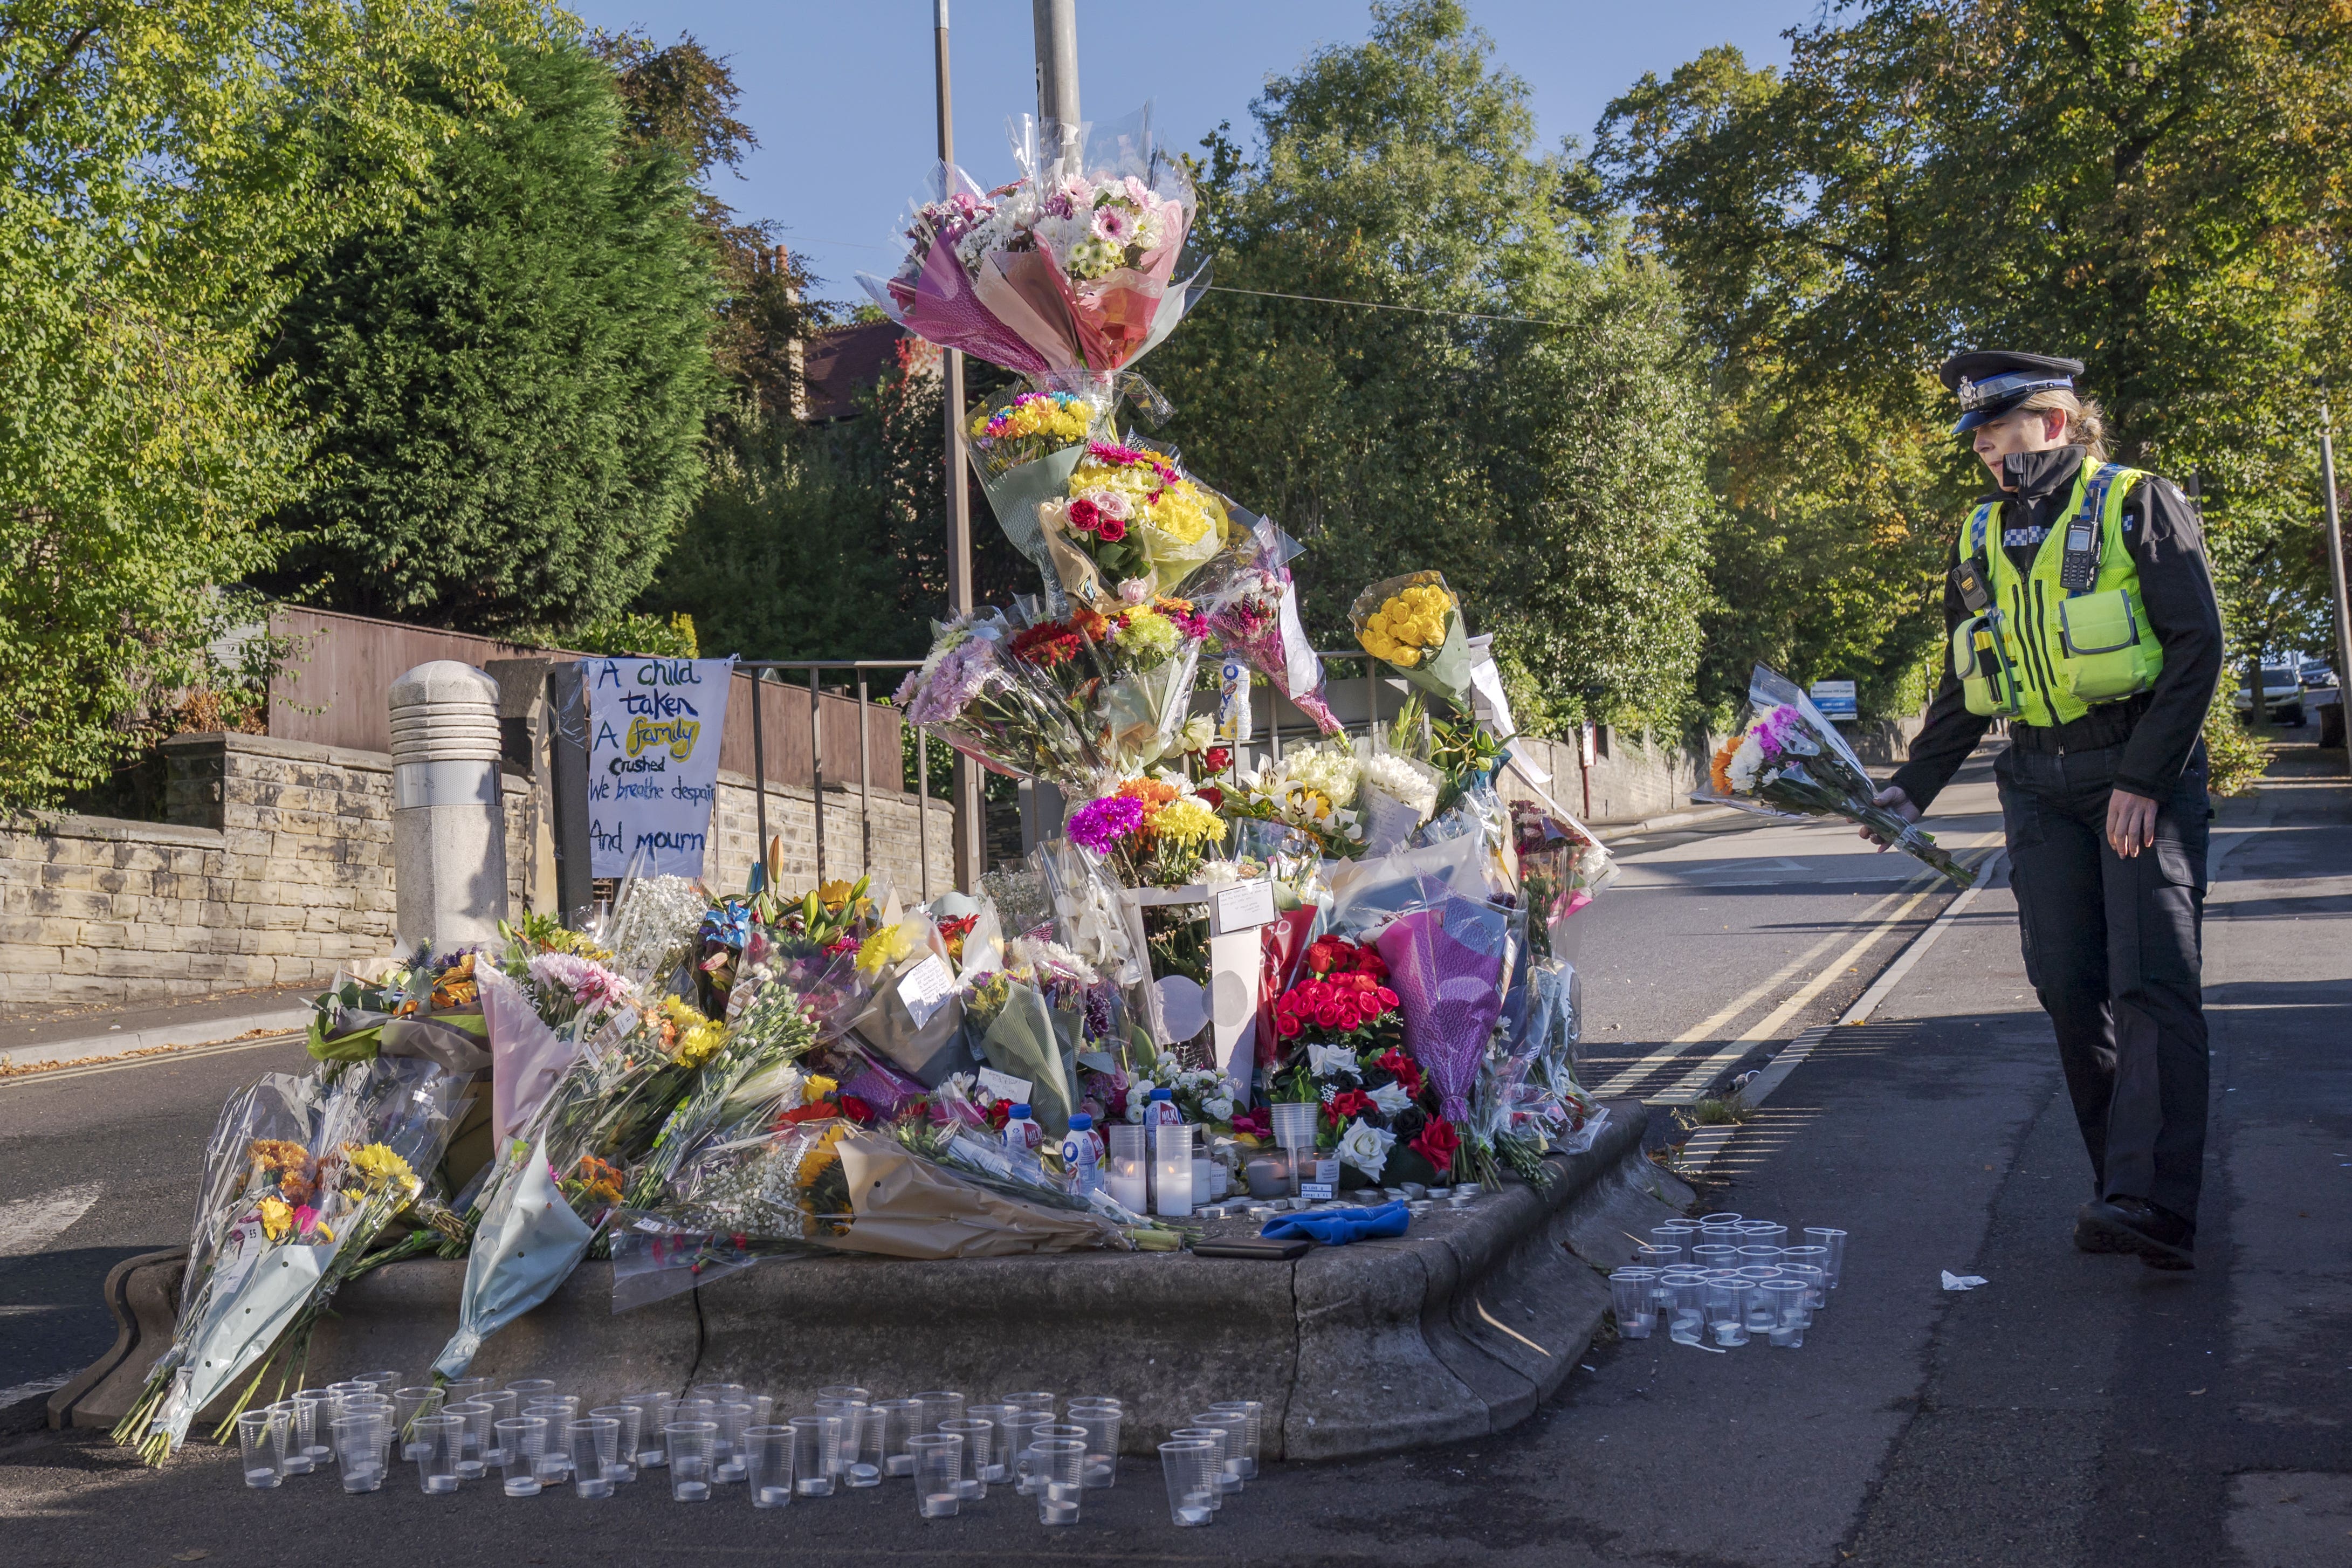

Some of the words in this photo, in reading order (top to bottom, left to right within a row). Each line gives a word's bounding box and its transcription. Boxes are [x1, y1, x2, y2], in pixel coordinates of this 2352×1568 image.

[597, 660, 621, 690] A
[637, 659, 702, 686] child
[618, 688, 699, 720] taken
[593, 720, 620, 752] A
[629, 719, 693, 759] family
[590, 775, 609, 802] We
[616, 776, 664, 800] breathe
[671, 775, 715, 807] despair
[590, 819, 623, 854] And
[636, 831, 705, 861] mourn
[1161, 1109, 1177, 1121] MILK
[1027, 1126, 1043, 1142] MILK
[783, 1133, 810, 1181] Seasonal
[249, 1228, 257, 1239] £5
